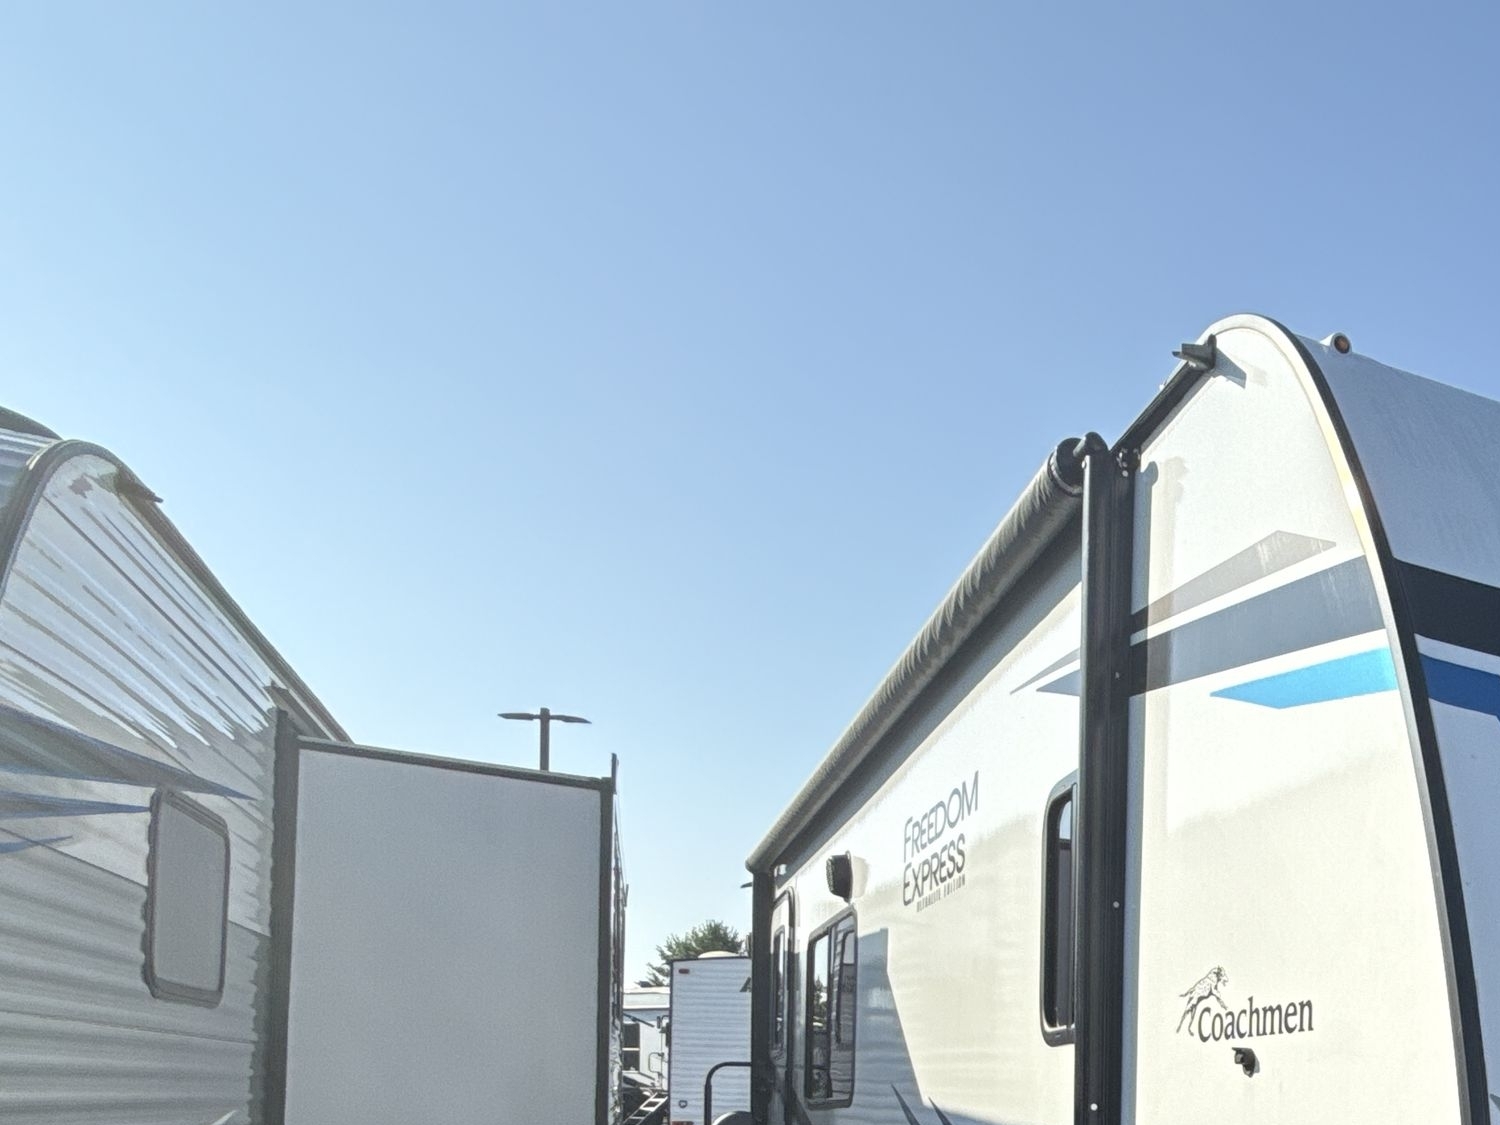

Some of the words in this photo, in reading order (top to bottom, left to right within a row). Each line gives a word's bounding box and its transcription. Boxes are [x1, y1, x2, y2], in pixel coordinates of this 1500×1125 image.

[903, 769, 979, 864] FREEDOM
[902, 832, 966, 907] EXPRESS
[1197, 995, 1315, 1043] Coachmen
